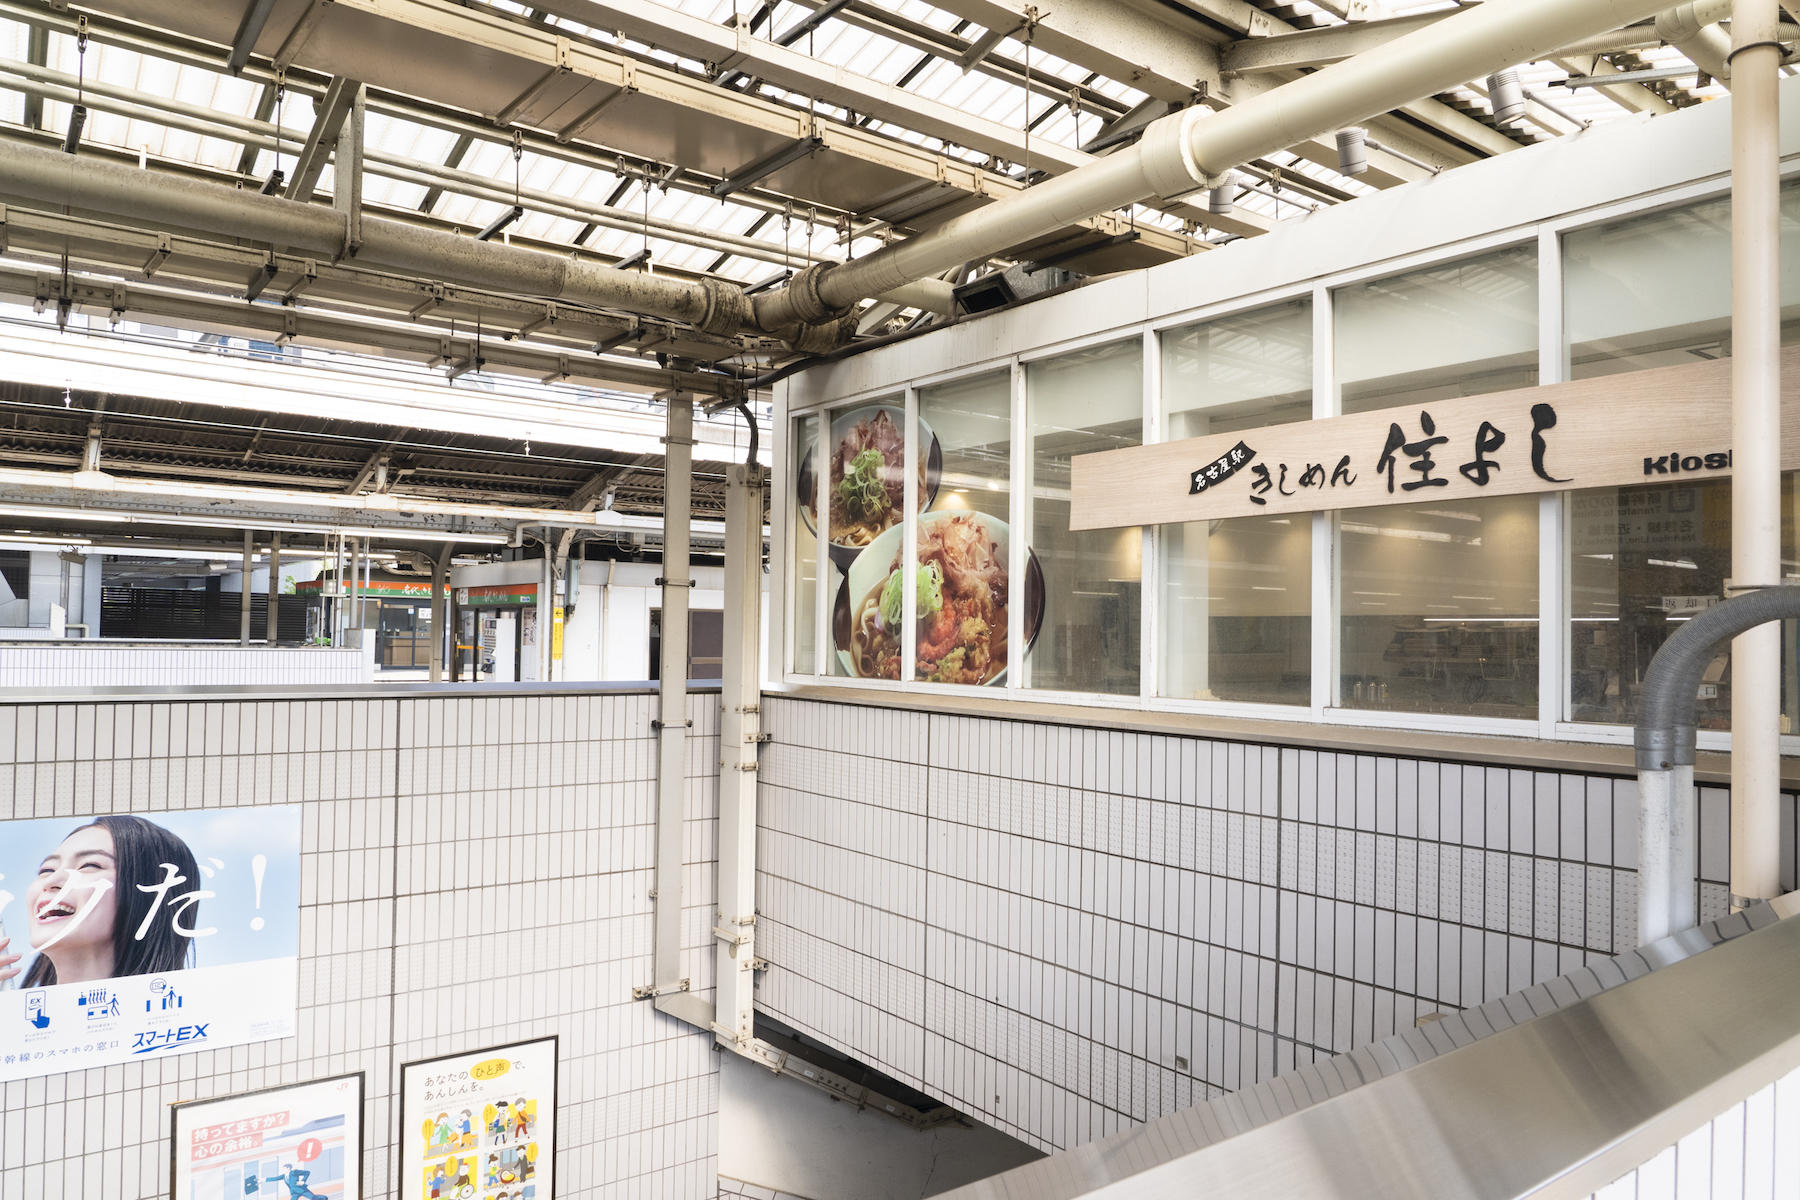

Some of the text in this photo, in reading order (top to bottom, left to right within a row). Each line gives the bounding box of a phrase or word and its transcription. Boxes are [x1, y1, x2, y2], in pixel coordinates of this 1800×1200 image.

[1195, 449, 1246, 491] 名古屋駅
[1250, 403, 1575, 505] きしめん 住よし
[1643, 449, 1732, 475] Kios
[0, 854, 267, 954] クだ!
[131, 1023, 210, 1048] スマートEX
[194, 1112, 287, 1141] 持ってますか?
